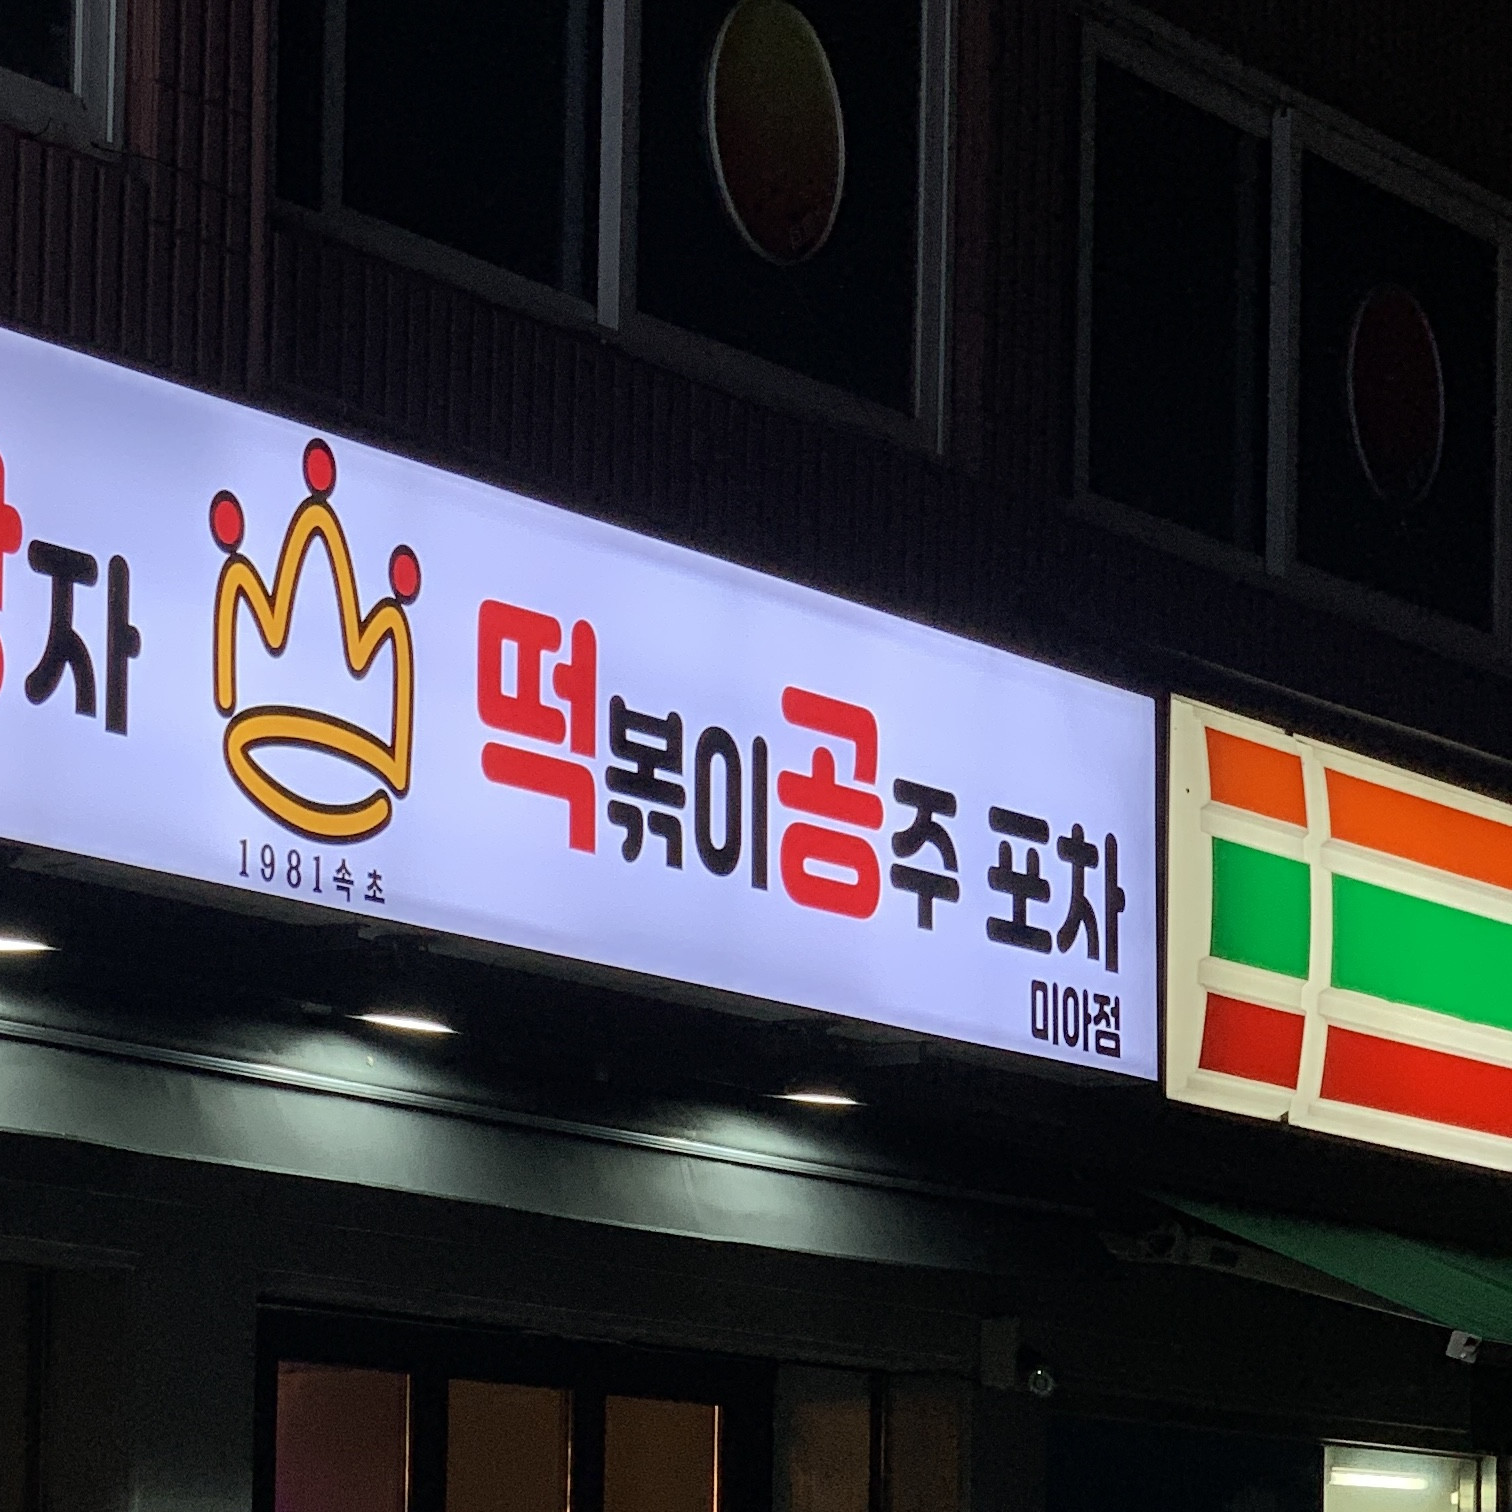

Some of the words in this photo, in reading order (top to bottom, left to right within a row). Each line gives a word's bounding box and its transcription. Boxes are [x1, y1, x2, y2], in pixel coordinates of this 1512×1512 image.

[477, 599, 960, 931] 떡볶이공주
[986, 806, 1126, 973] 포차
[239, 839, 386, 904] 1981속초
[1030, 979, 1121, 1058] 미아점
